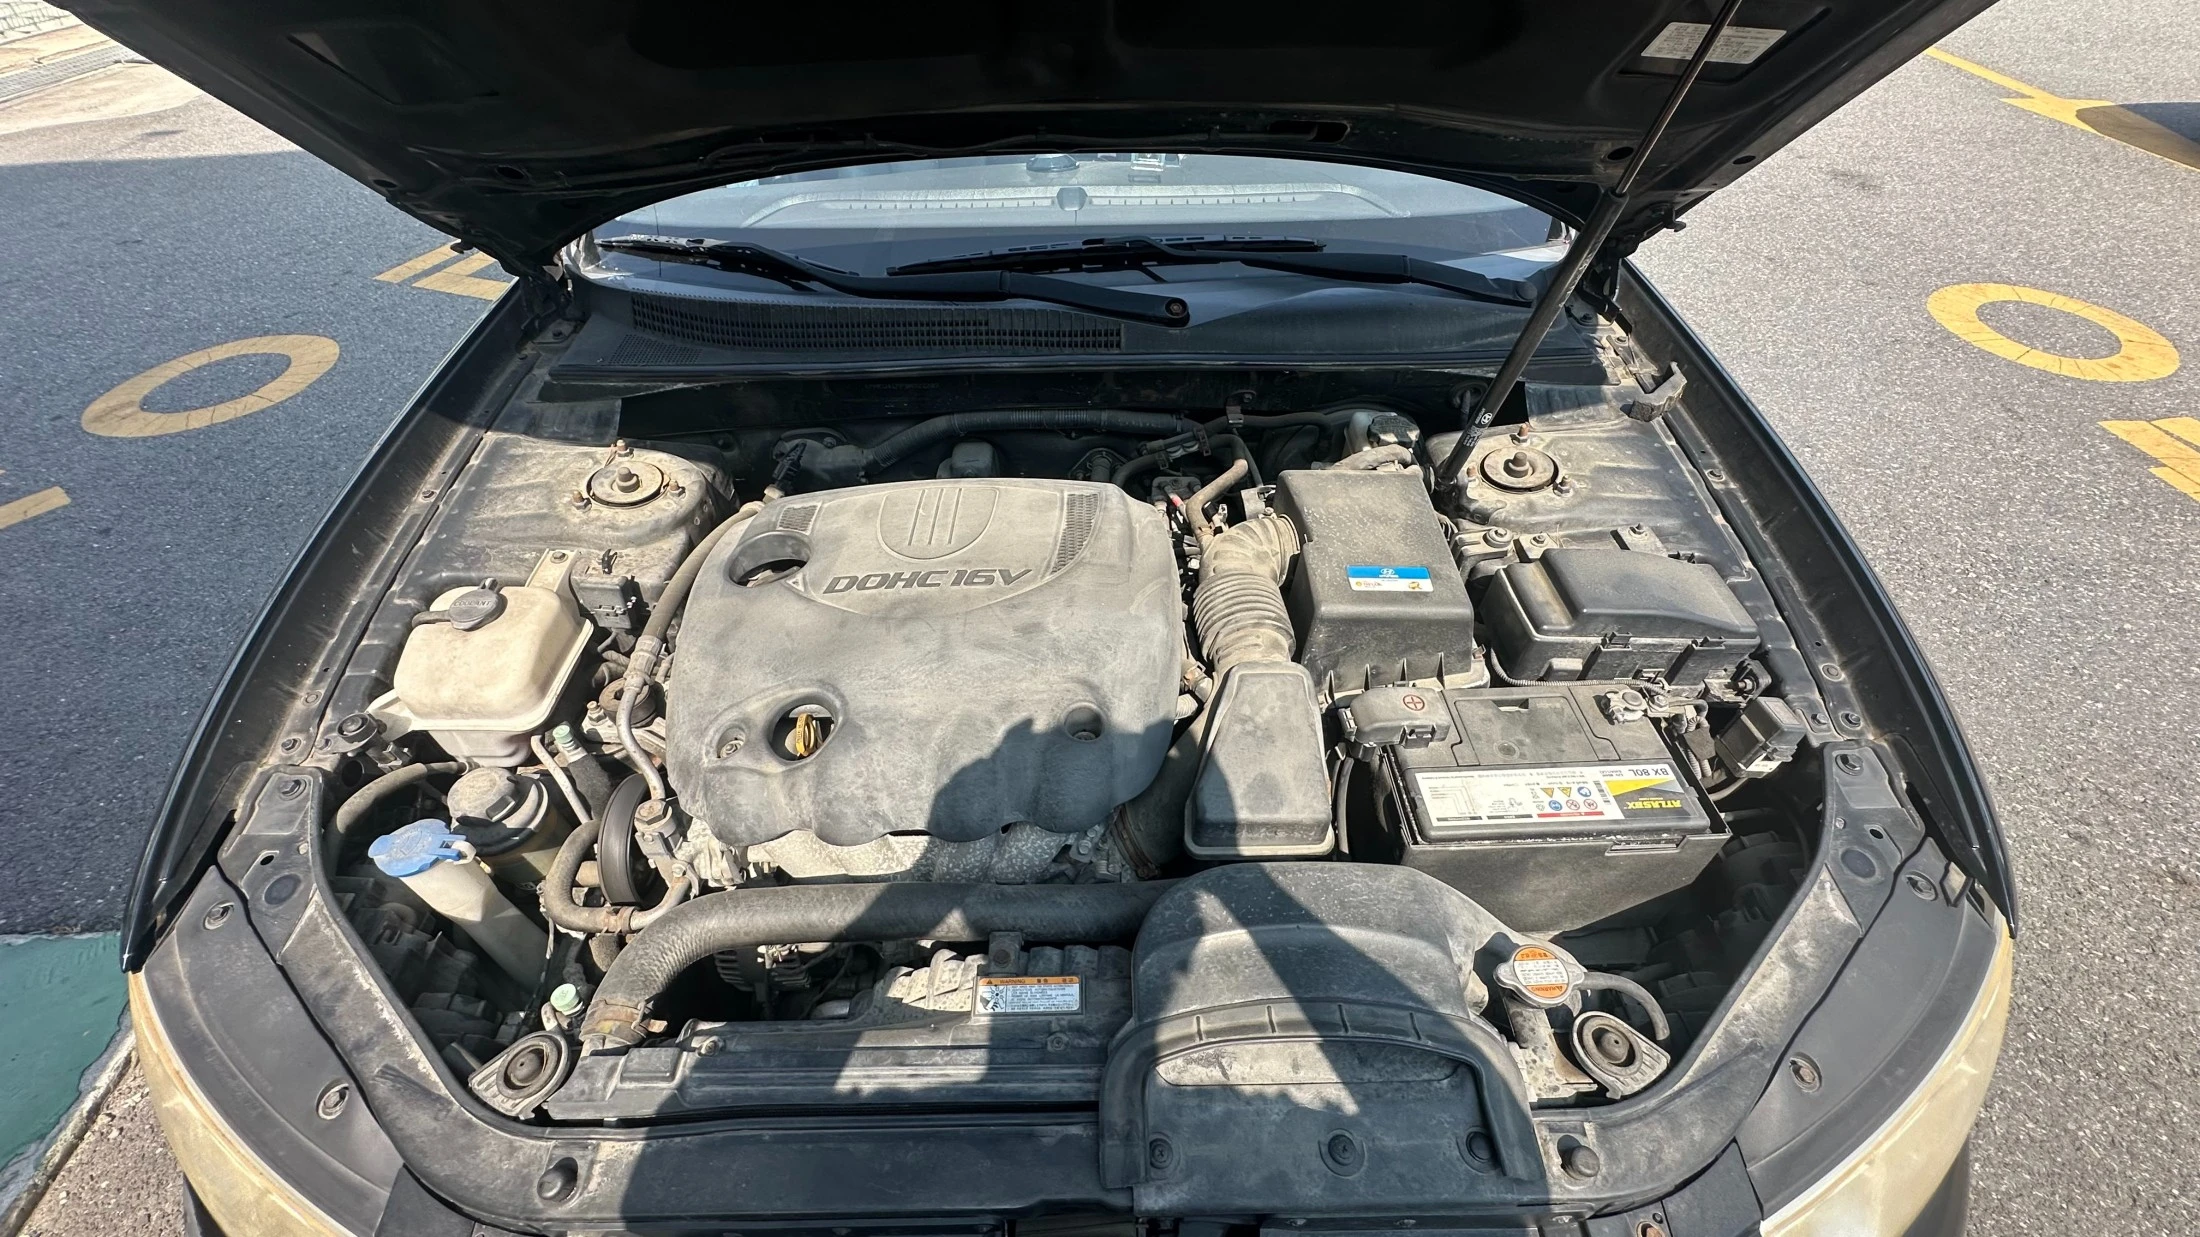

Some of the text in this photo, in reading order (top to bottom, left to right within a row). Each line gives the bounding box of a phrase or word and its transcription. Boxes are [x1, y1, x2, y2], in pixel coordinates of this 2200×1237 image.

[822, 568, 1033, 594] DOHC 16V
[453, 599, 492, 607] COOLANT
[1628, 767, 1650, 777] 80L
[1652, 767, 1669, 777] BX
[1626, 799, 1682, 810] ATLASBX
